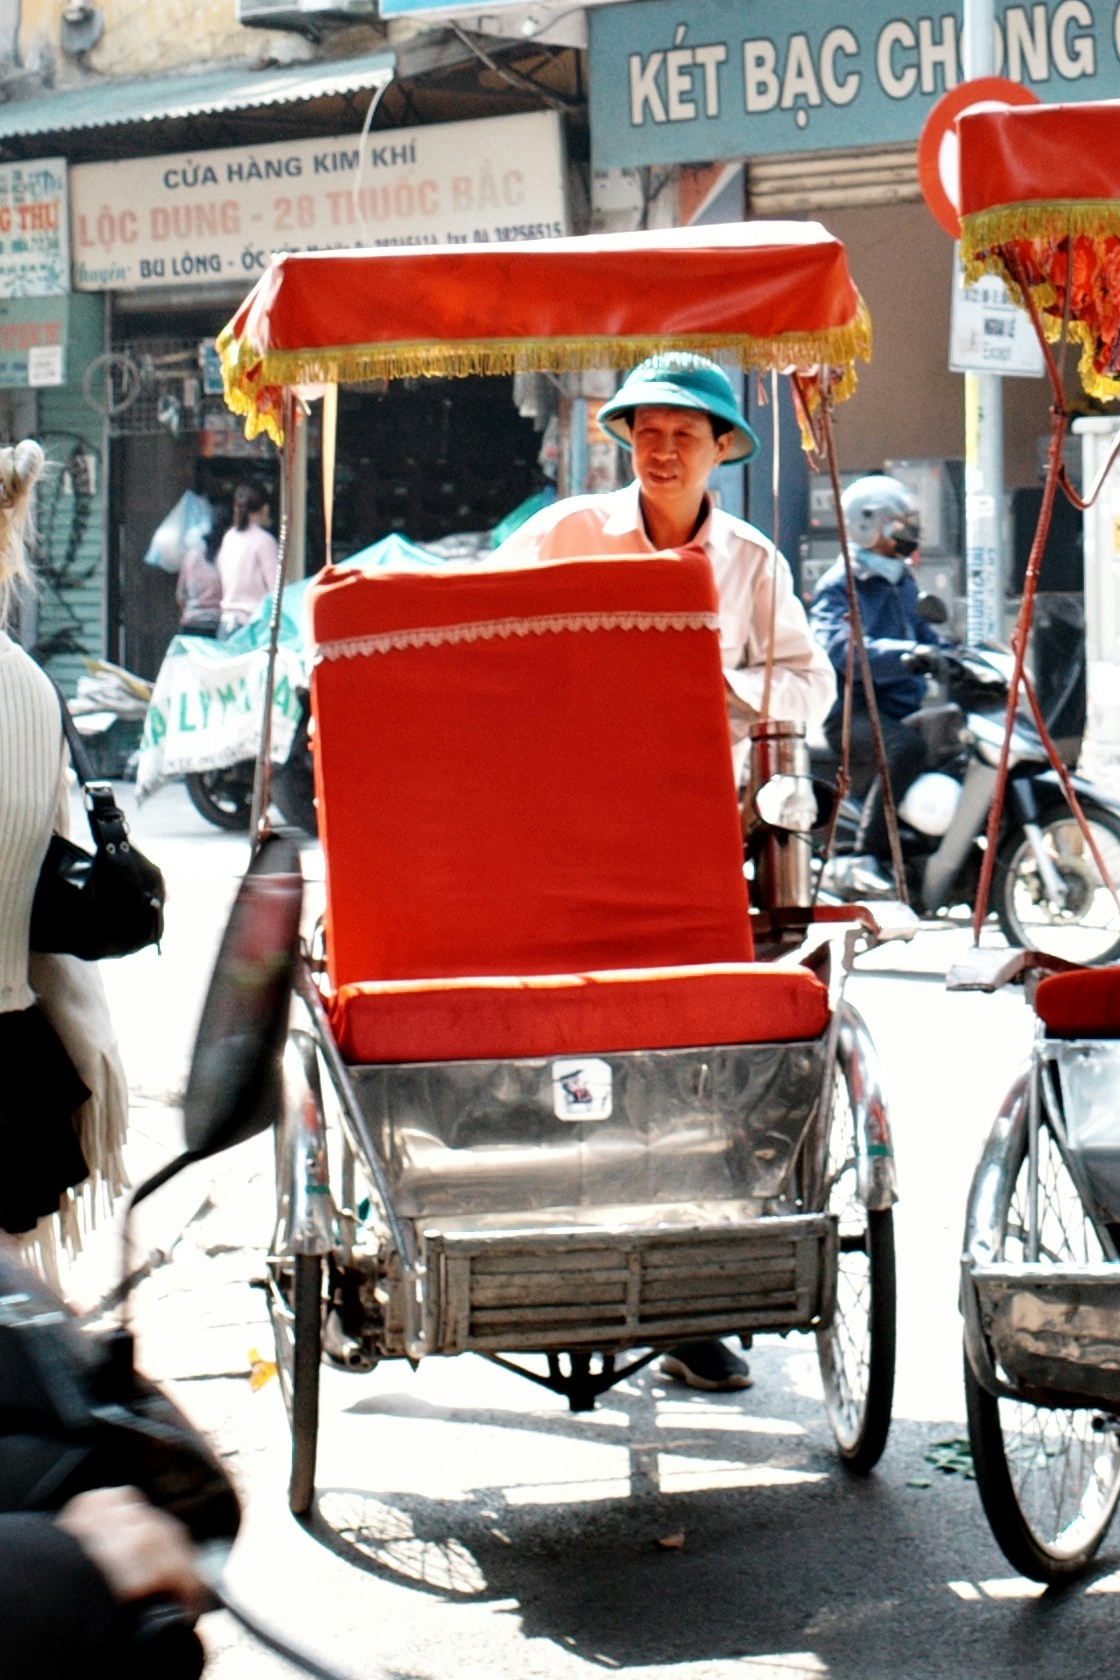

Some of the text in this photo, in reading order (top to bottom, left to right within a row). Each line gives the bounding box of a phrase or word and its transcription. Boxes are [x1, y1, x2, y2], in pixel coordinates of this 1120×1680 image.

[628, 23, 728, 126] KÉT
[743, 26, 862, 128] BẠC
[163, 138, 417, 190] CỬA HÀNG KIM KHÍ
[79, 207, 138, 253] LỘC
[326, 168, 441, 224] THUỐC
[141, 259, 165, 278] BU
[172, 252, 222, 276] LÔNG
